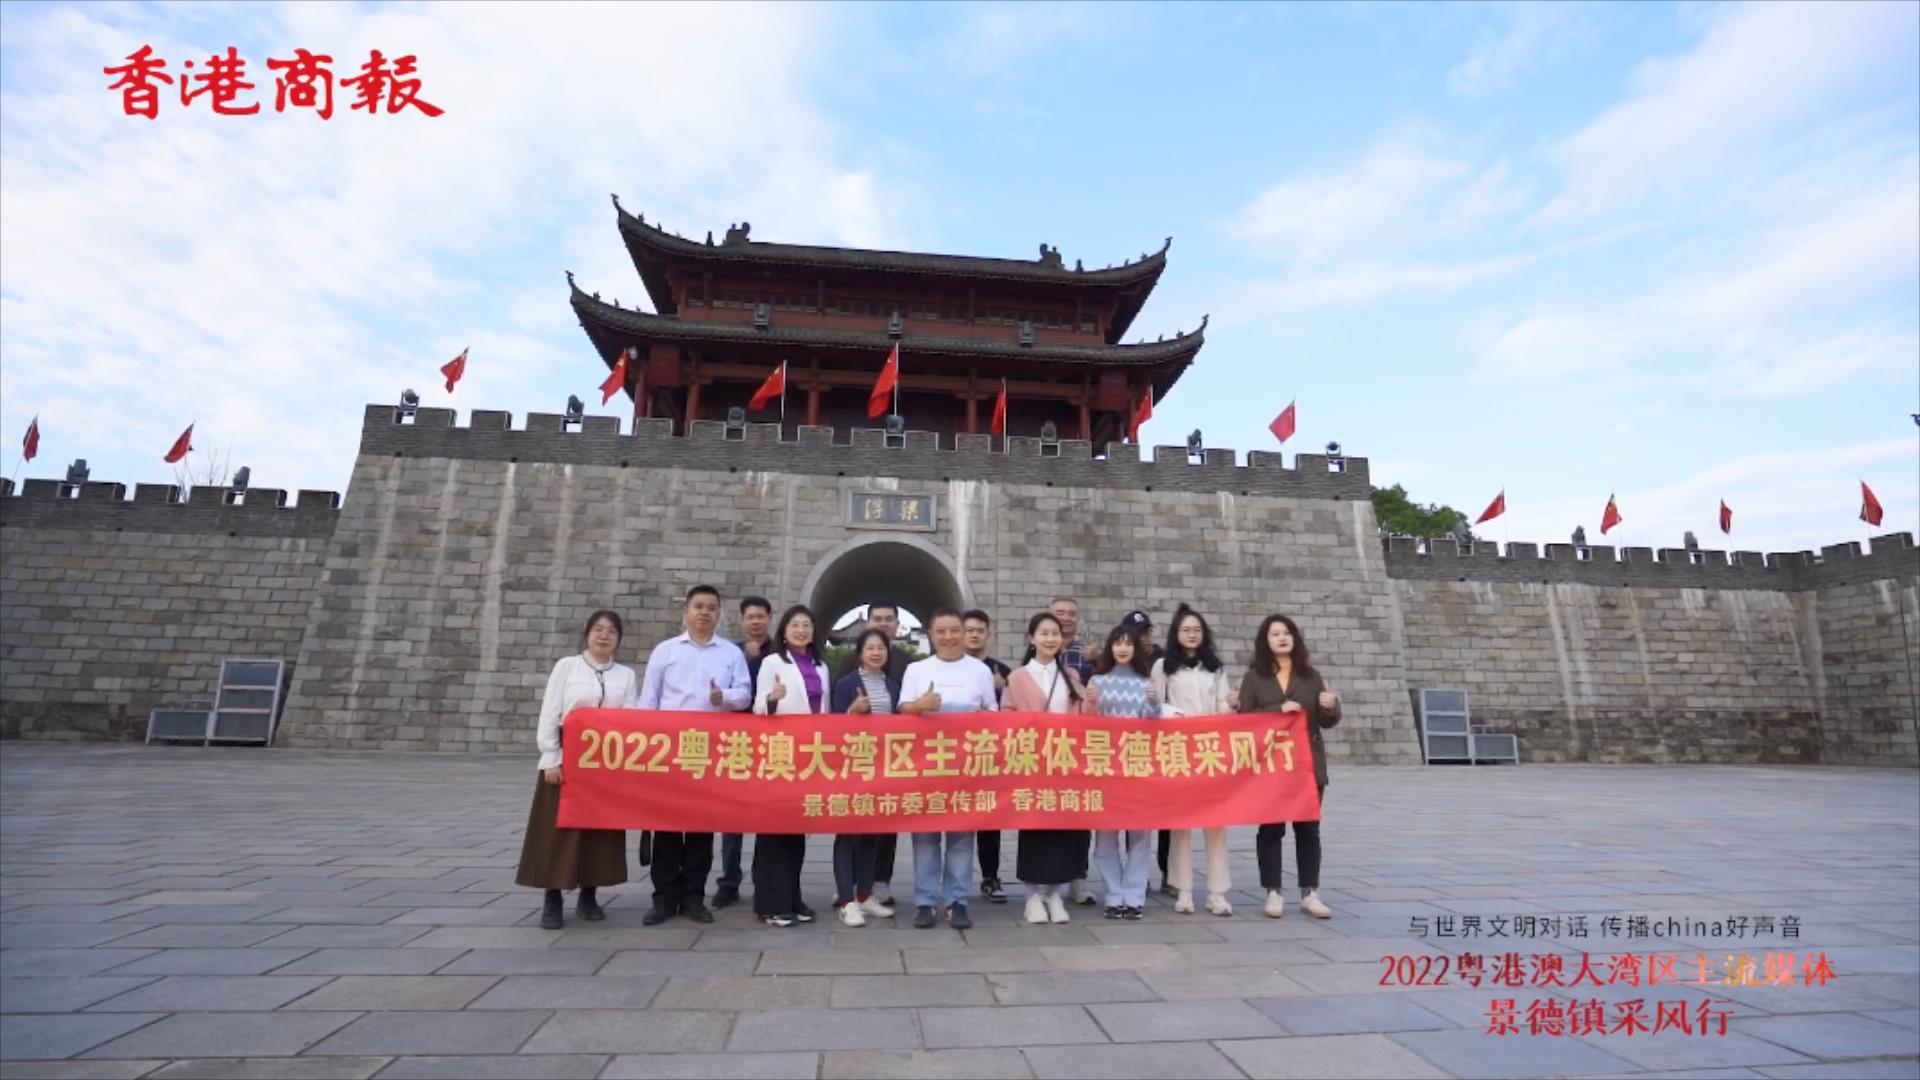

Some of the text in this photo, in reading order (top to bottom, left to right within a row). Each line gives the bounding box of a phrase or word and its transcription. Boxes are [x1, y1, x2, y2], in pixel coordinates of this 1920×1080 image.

[578, 728, 1296, 781] 2022粤港澳大湾区主流媒体景德镇采风行
[803, 787, 1106, 817] 景德镇市委宣传部 香港商报
